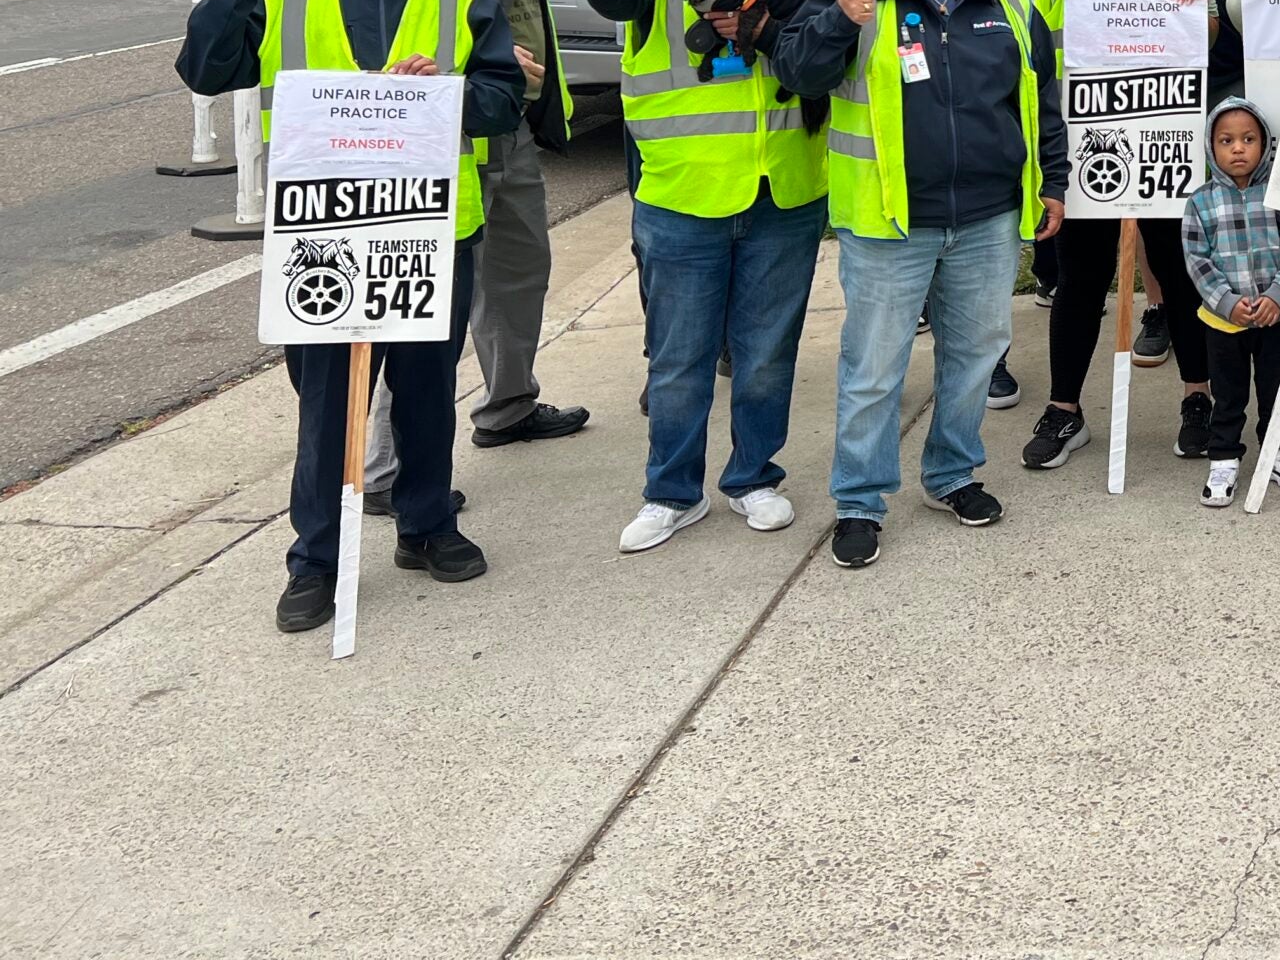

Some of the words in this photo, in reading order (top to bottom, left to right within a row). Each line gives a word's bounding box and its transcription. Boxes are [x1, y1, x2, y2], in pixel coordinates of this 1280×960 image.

[1093, 2, 1137, 12] UNFAIR
[1140, 2, 1180, 12] LABOR
[1107, 17, 1166, 27] PRACTICE
[1108, 44, 1165, 54] TRANSDEV
[312, 88, 370, 101] UNFAIR
[375, 90, 427, 102] LABOR
[1074, 82, 1108, 114] ON
[1114, 74, 1196, 112] STRIKE
[330, 107, 407, 119] PRACTICE
[1140, 130, 1193, 142] TEAMSTERS
[329, 138, 405, 150] TRANSDEV
[1139, 142, 1192, 163] LOCAL
[1138, 165, 1192, 199] 542
[282, 185, 326, 222] ON
[334, 178, 442, 218] STRIKE
[368, 239, 438, 253] TEAMSTERS
[366, 254, 436, 279] LOCAL
[364, 280, 435, 320] 542
